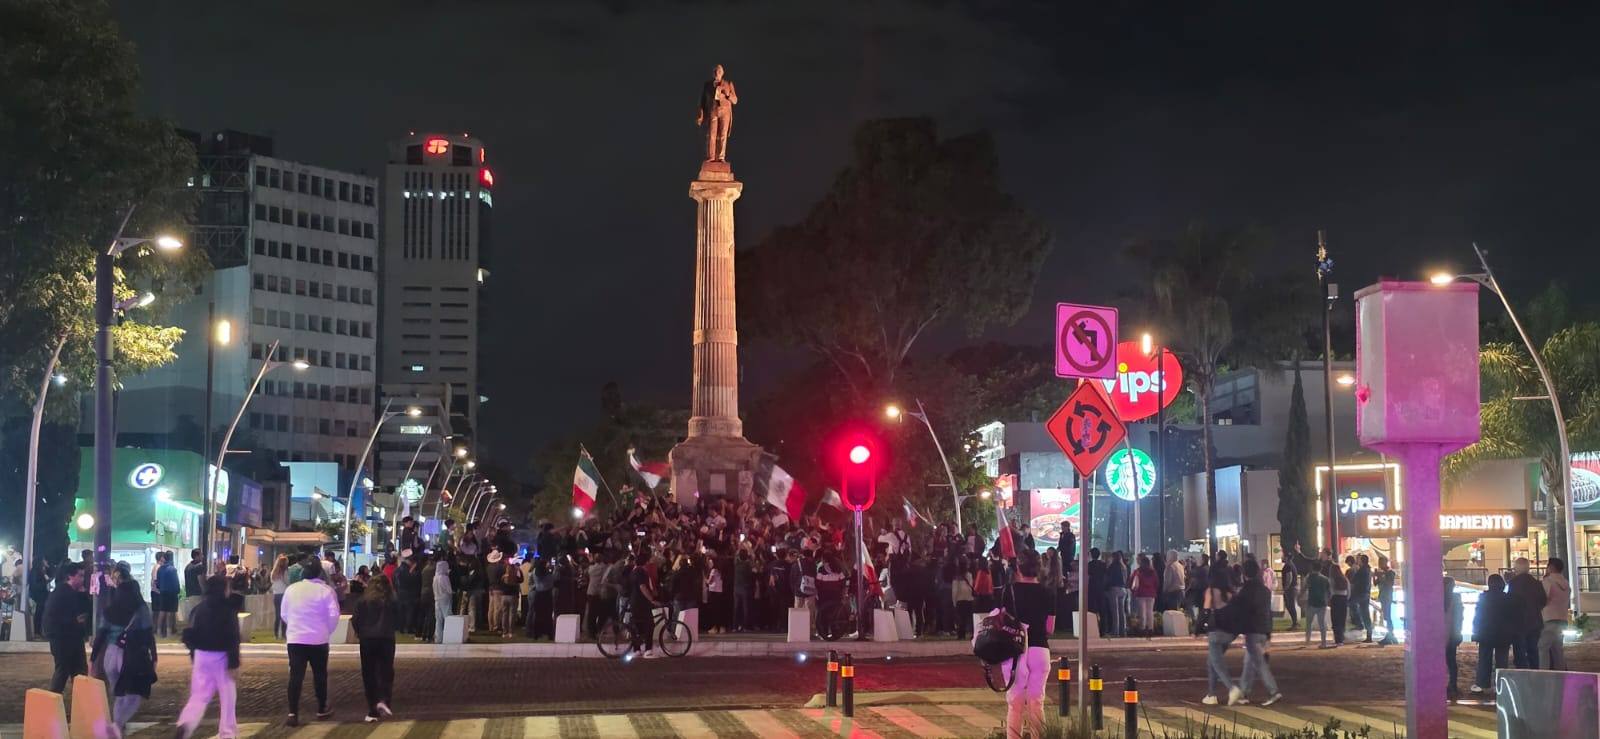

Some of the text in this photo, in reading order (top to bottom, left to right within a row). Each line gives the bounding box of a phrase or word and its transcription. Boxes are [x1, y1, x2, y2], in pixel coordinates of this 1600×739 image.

[1101, 362, 1167, 403] vips
[1338, 491, 1386, 514] vips
[1367, 515, 1514, 530] ESTAMIENTO
